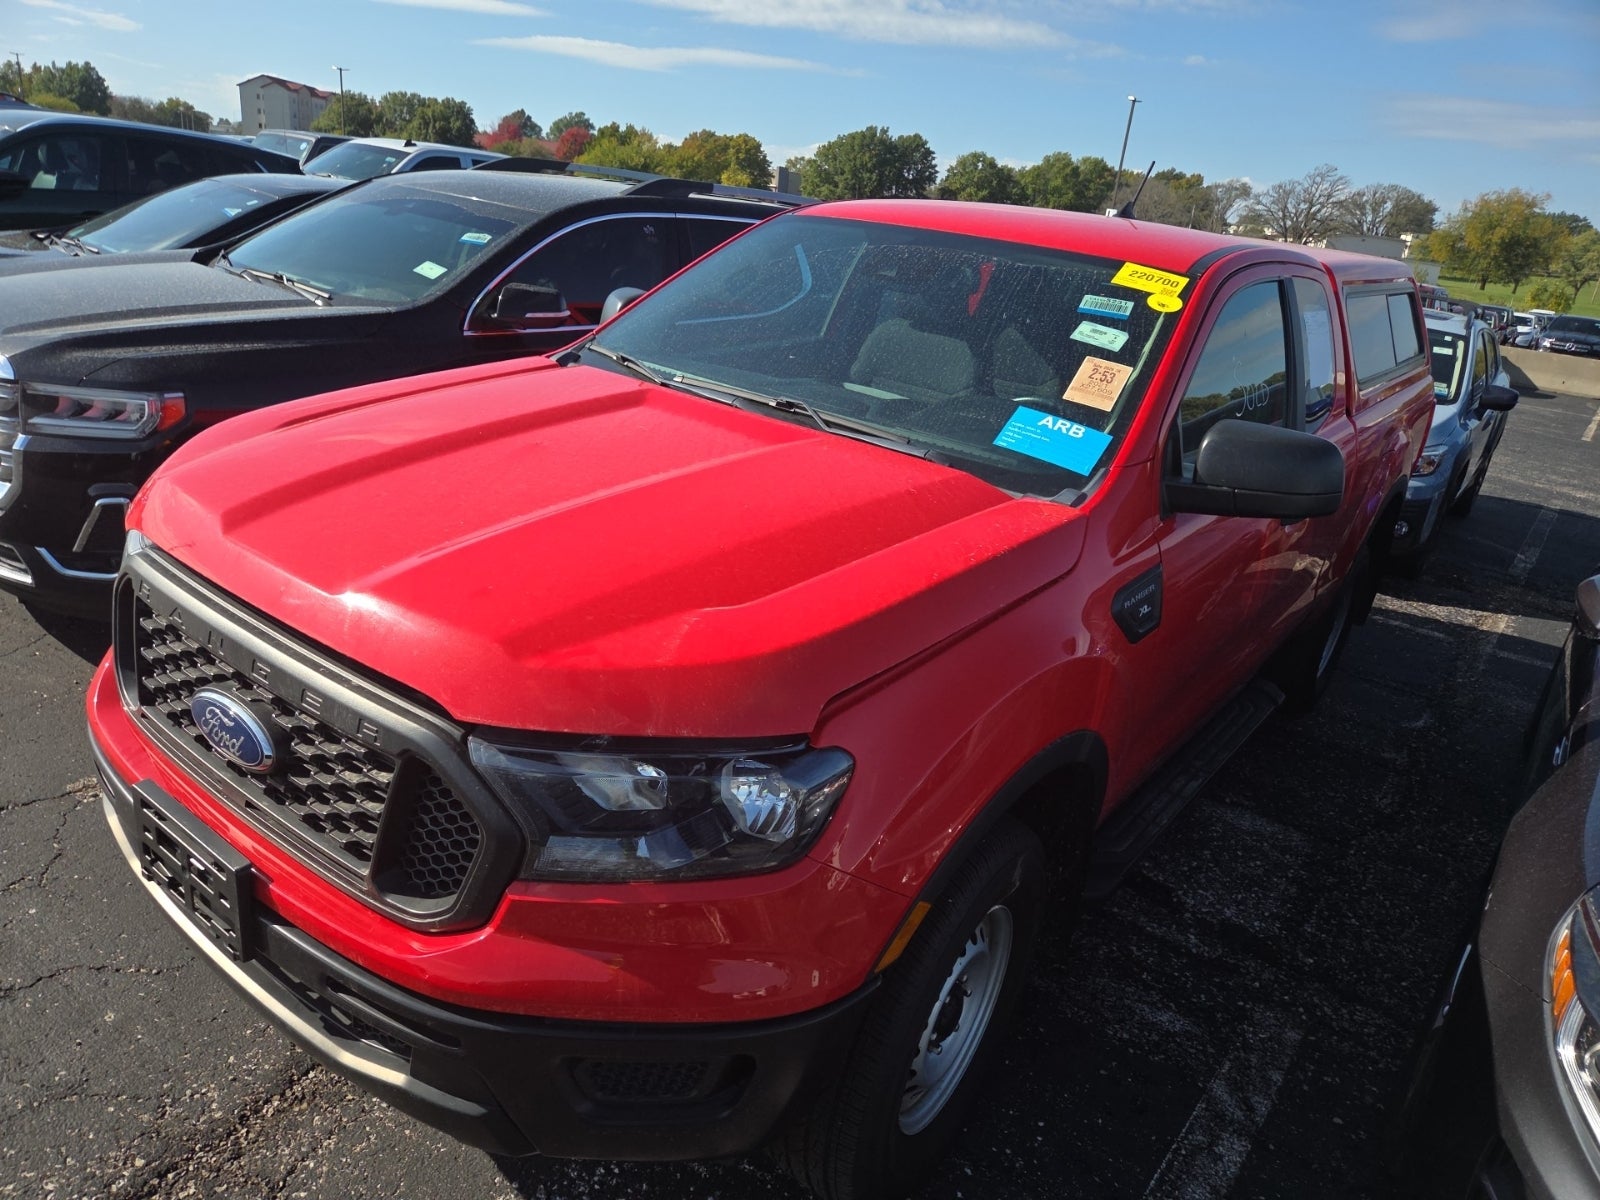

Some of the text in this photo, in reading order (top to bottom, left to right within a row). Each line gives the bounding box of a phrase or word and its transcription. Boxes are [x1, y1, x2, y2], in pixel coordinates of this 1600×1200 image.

[1128, 270, 1180, 288] 220700
[1088, 367, 1116, 384] 2:53
[1037, 415, 1086, 439] ARB
[1124, 584, 1156, 609] RANGER
[1139, 604, 1152, 617] XL
[201, 706, 245, 757] Ford
